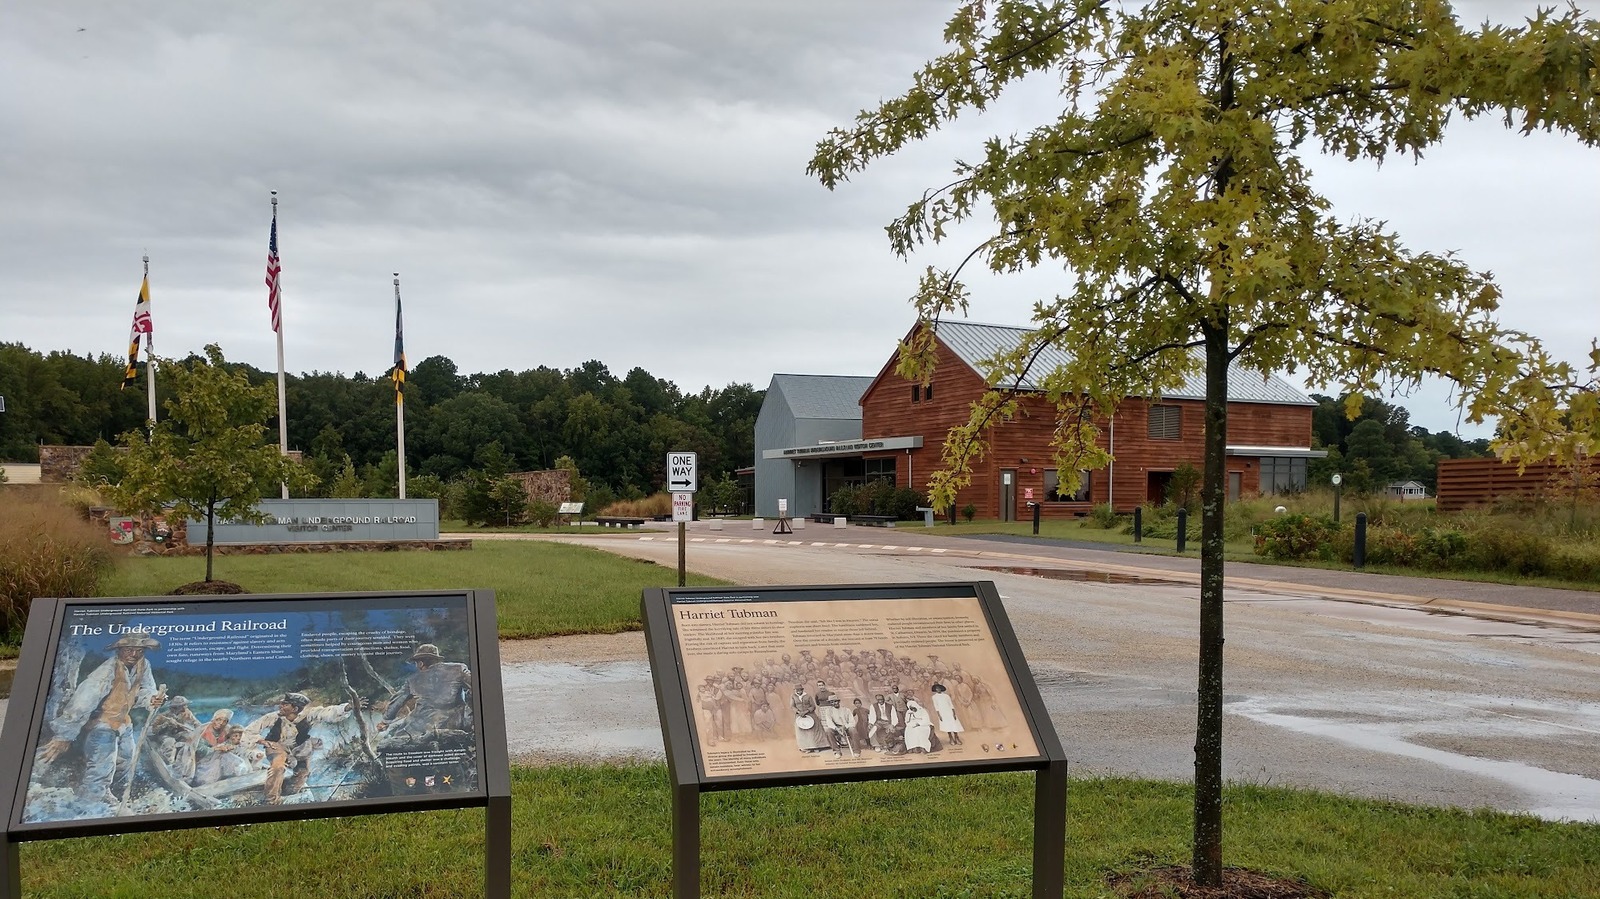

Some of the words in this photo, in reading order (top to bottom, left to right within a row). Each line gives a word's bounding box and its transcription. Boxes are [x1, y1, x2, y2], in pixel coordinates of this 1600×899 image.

[672, 456, 692, 465] ONE
[672, 467, 692, 476] WAY
[680, 610, 725, 619] Harriet
[728, 609, 778, 619] Tubman
[70, 624, 102, 636] The
[108, 622, 215, 636] Underground
[221, 619, 287, 631] Railroad
